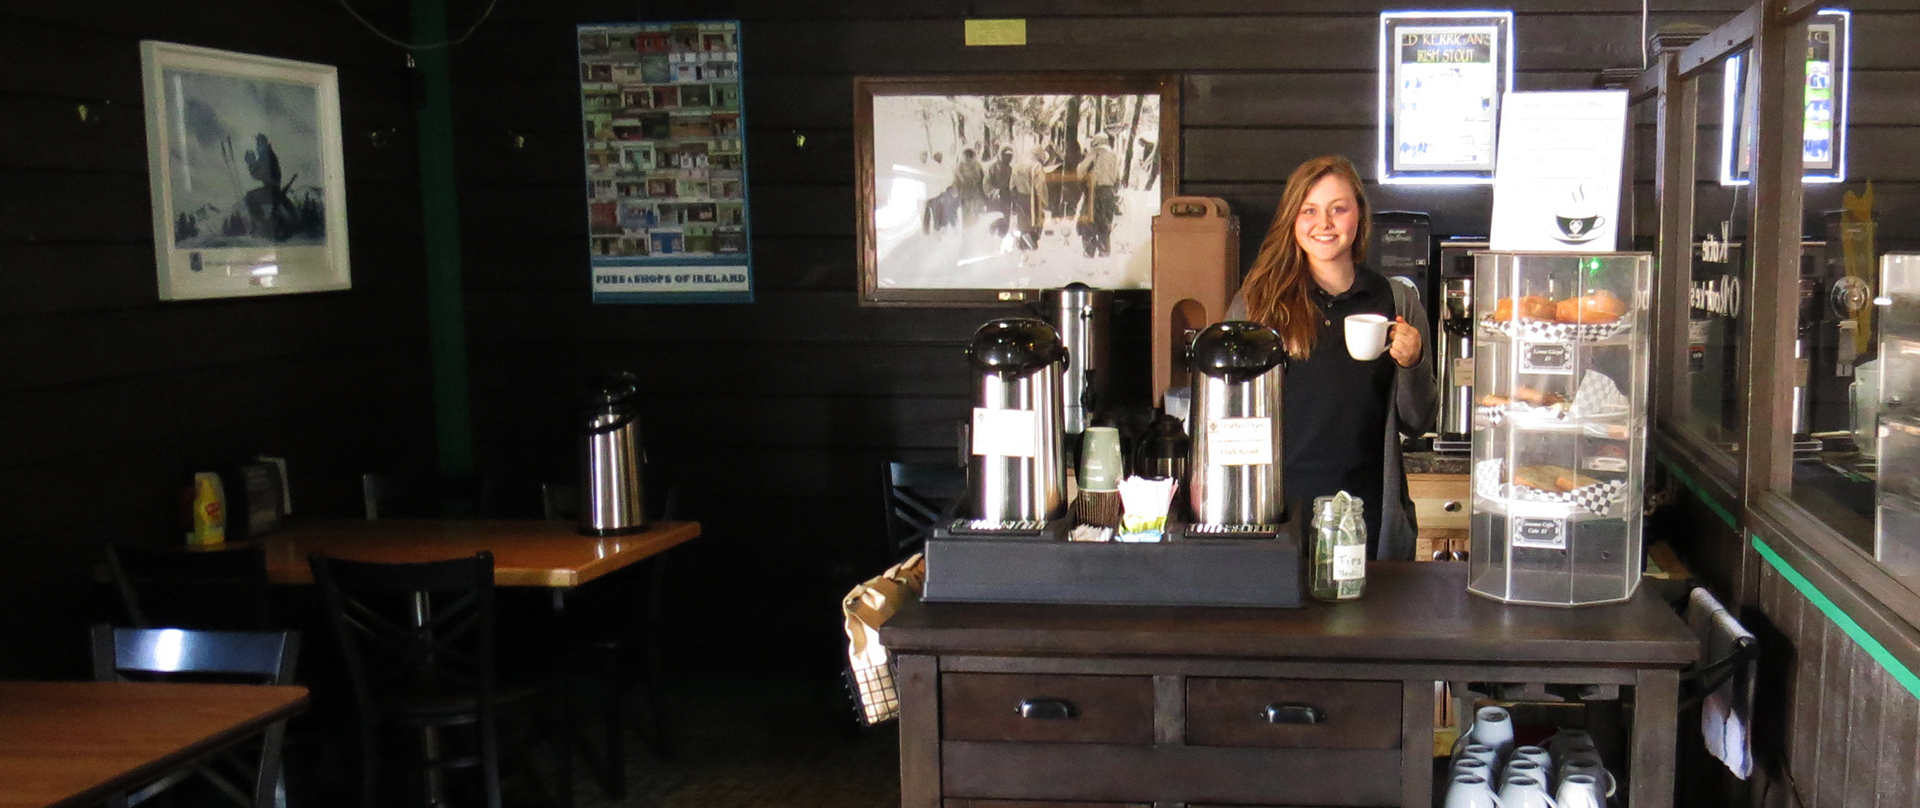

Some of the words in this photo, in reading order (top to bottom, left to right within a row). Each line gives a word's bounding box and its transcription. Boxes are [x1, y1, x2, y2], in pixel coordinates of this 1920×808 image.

[1417, 49, 1439, 62] IRISH
[1442, 48, 1475, 63] STOUT
[634, 274, 672, 284] SHOPS
[675, 274, 690, 284] OF
[693, 274, 746, 284] IRELAND
[1338, 554, 1361, 566] Tips
